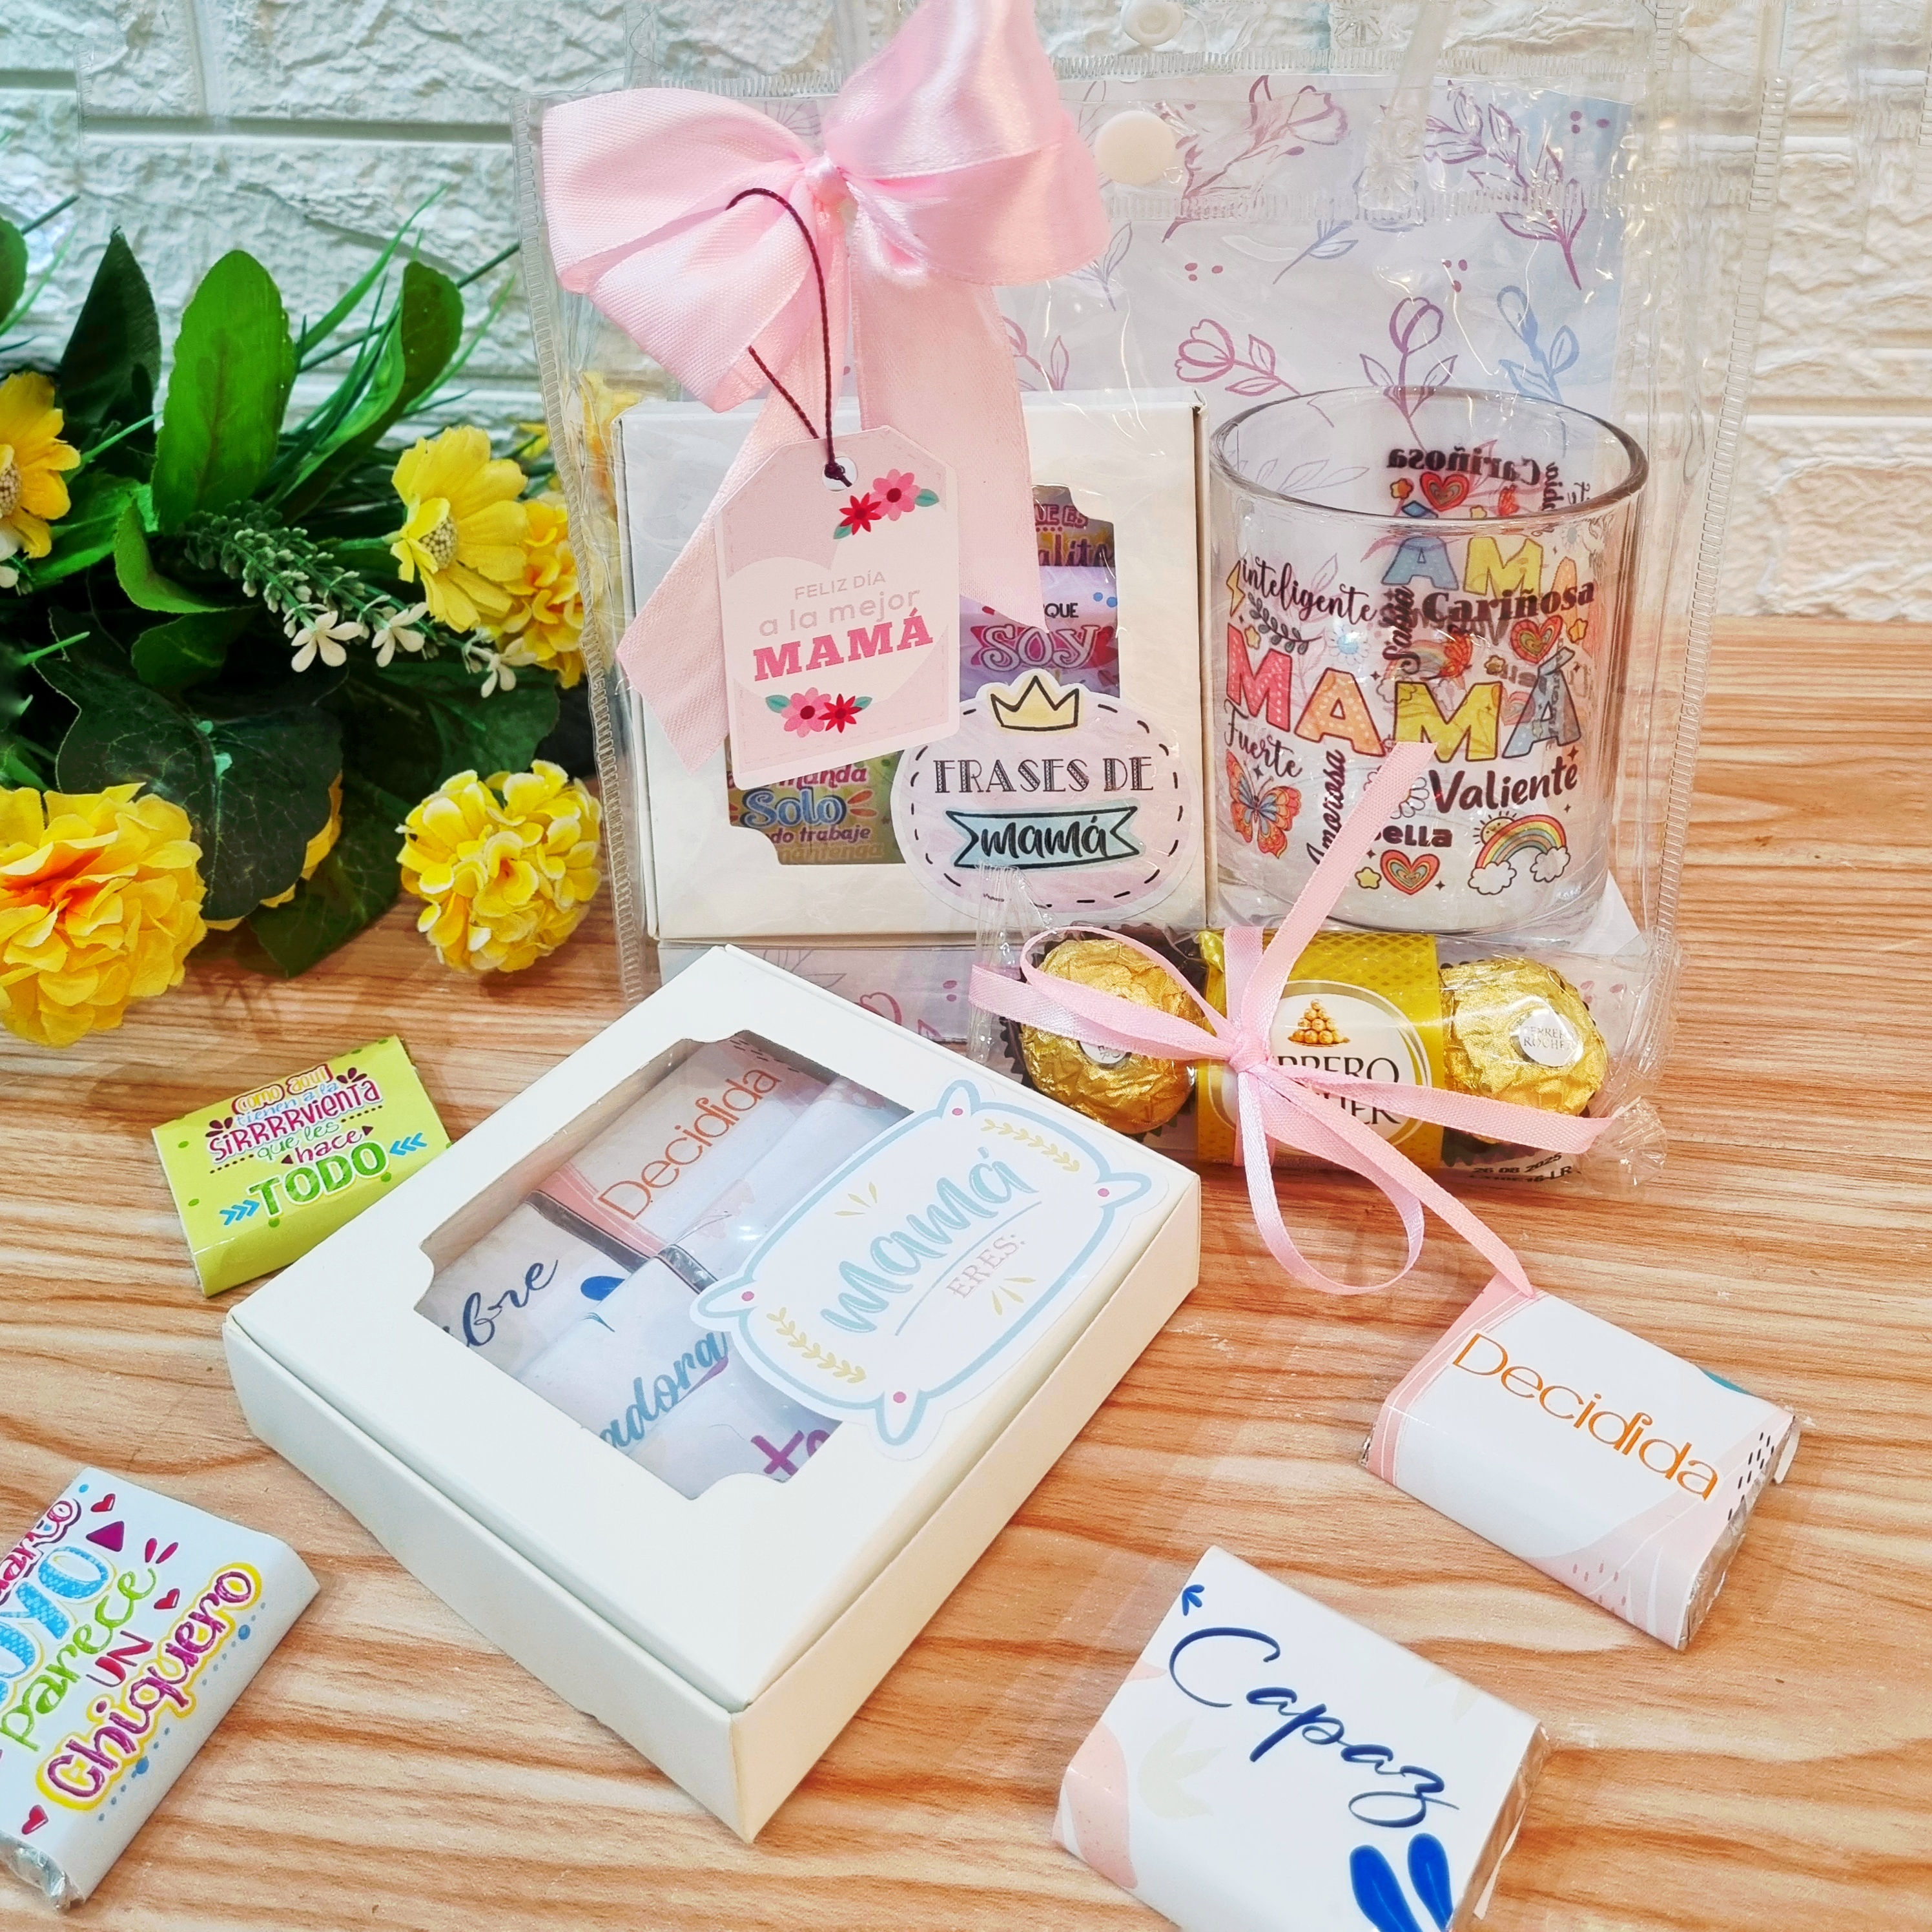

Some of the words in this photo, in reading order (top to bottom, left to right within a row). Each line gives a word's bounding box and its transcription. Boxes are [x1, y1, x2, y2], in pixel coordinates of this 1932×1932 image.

[795, 578, 847, 601] FELIZ
[854, 571, 886, 589] DÍA
[1043, 602, 1079, 618] QUE
[1242, 554, 1378, 624] inteligente
[1423, 581, 1595, 622] Cariñosa
[760, 617, 779, 636] a
[790, 609, 818, 631] la
[830, 590, 921, 624] mejor
[754, 608, 934, 682] MAMÁ
[980, 624, 1100, 672] SOY
[1227, 622, 1582, 763] MAMÁ
[1223, 699, 1302, 777] Fuerte
[934, 759, 1090, 794] FRASES
[1103, 756, 1155, 792] DE
[1428, 755, 1578, 814] Valiente
[740, 786, 847, 827] Solo
[800, 825, 871, 844] trabaje
[981, 815, 1108, 859] mamá
[235, 1085, 283, 1114] como
[237, 1098, 297, 1126] tienen
[303, 1091, 314, 1103] a
[320, 1081, 338, 1095] la
[258, 1136, 300, 1161] que
[304, 1120, 340, 1141] les
[294, 1130, 363, 1164] hace
[598, 1067, 782, 1220] Decidida
[248, 1142, 388, 1217] TODO
[452, 1259, 558, 1348] bre
[1452, 1333, 1718, 1501] Decidida
[1, 1568, 156, 1752] parece
[46, 1570, 252, 1798] Chiquero
[87, 1630, 154, 1688] UN
[1169, 1627, 1460, 1828] Capaz
